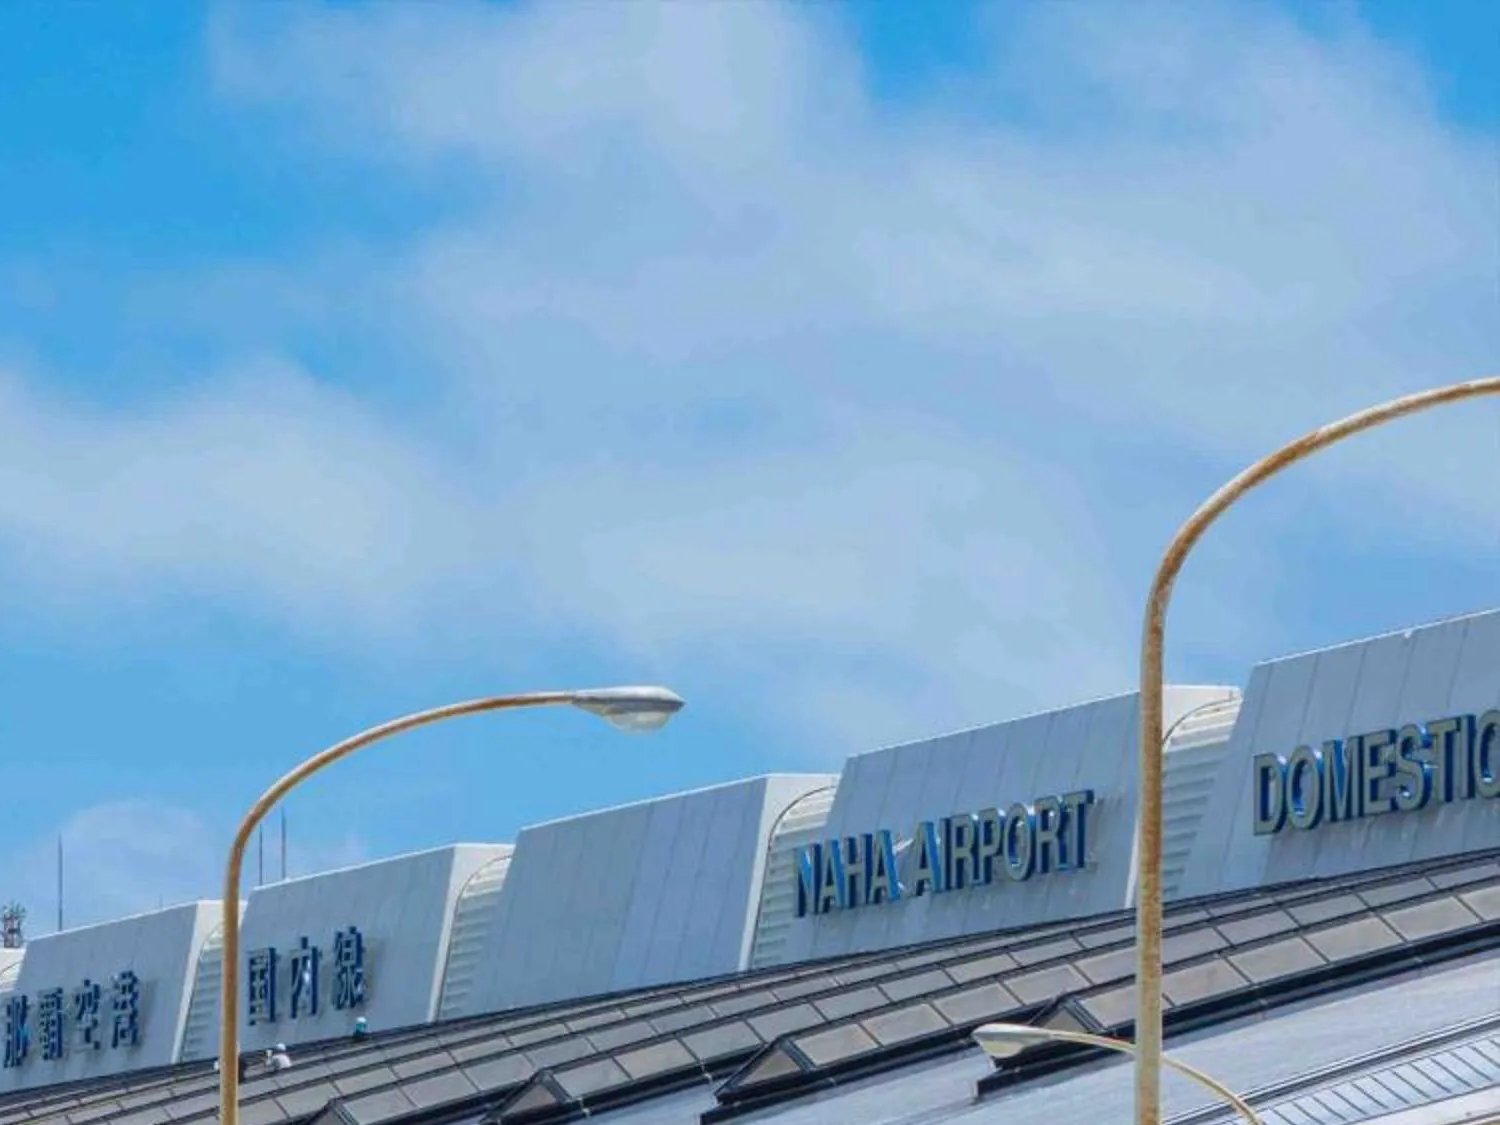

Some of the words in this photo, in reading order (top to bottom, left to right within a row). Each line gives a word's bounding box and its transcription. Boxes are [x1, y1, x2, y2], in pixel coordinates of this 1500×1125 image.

[795, 829, 901, 918] NAHA
[912, 790, 1093, 897] AIRPORT
[3, 970, 139, 1068] 那覇空港
[247, 925, 364, 1026] 国内線
